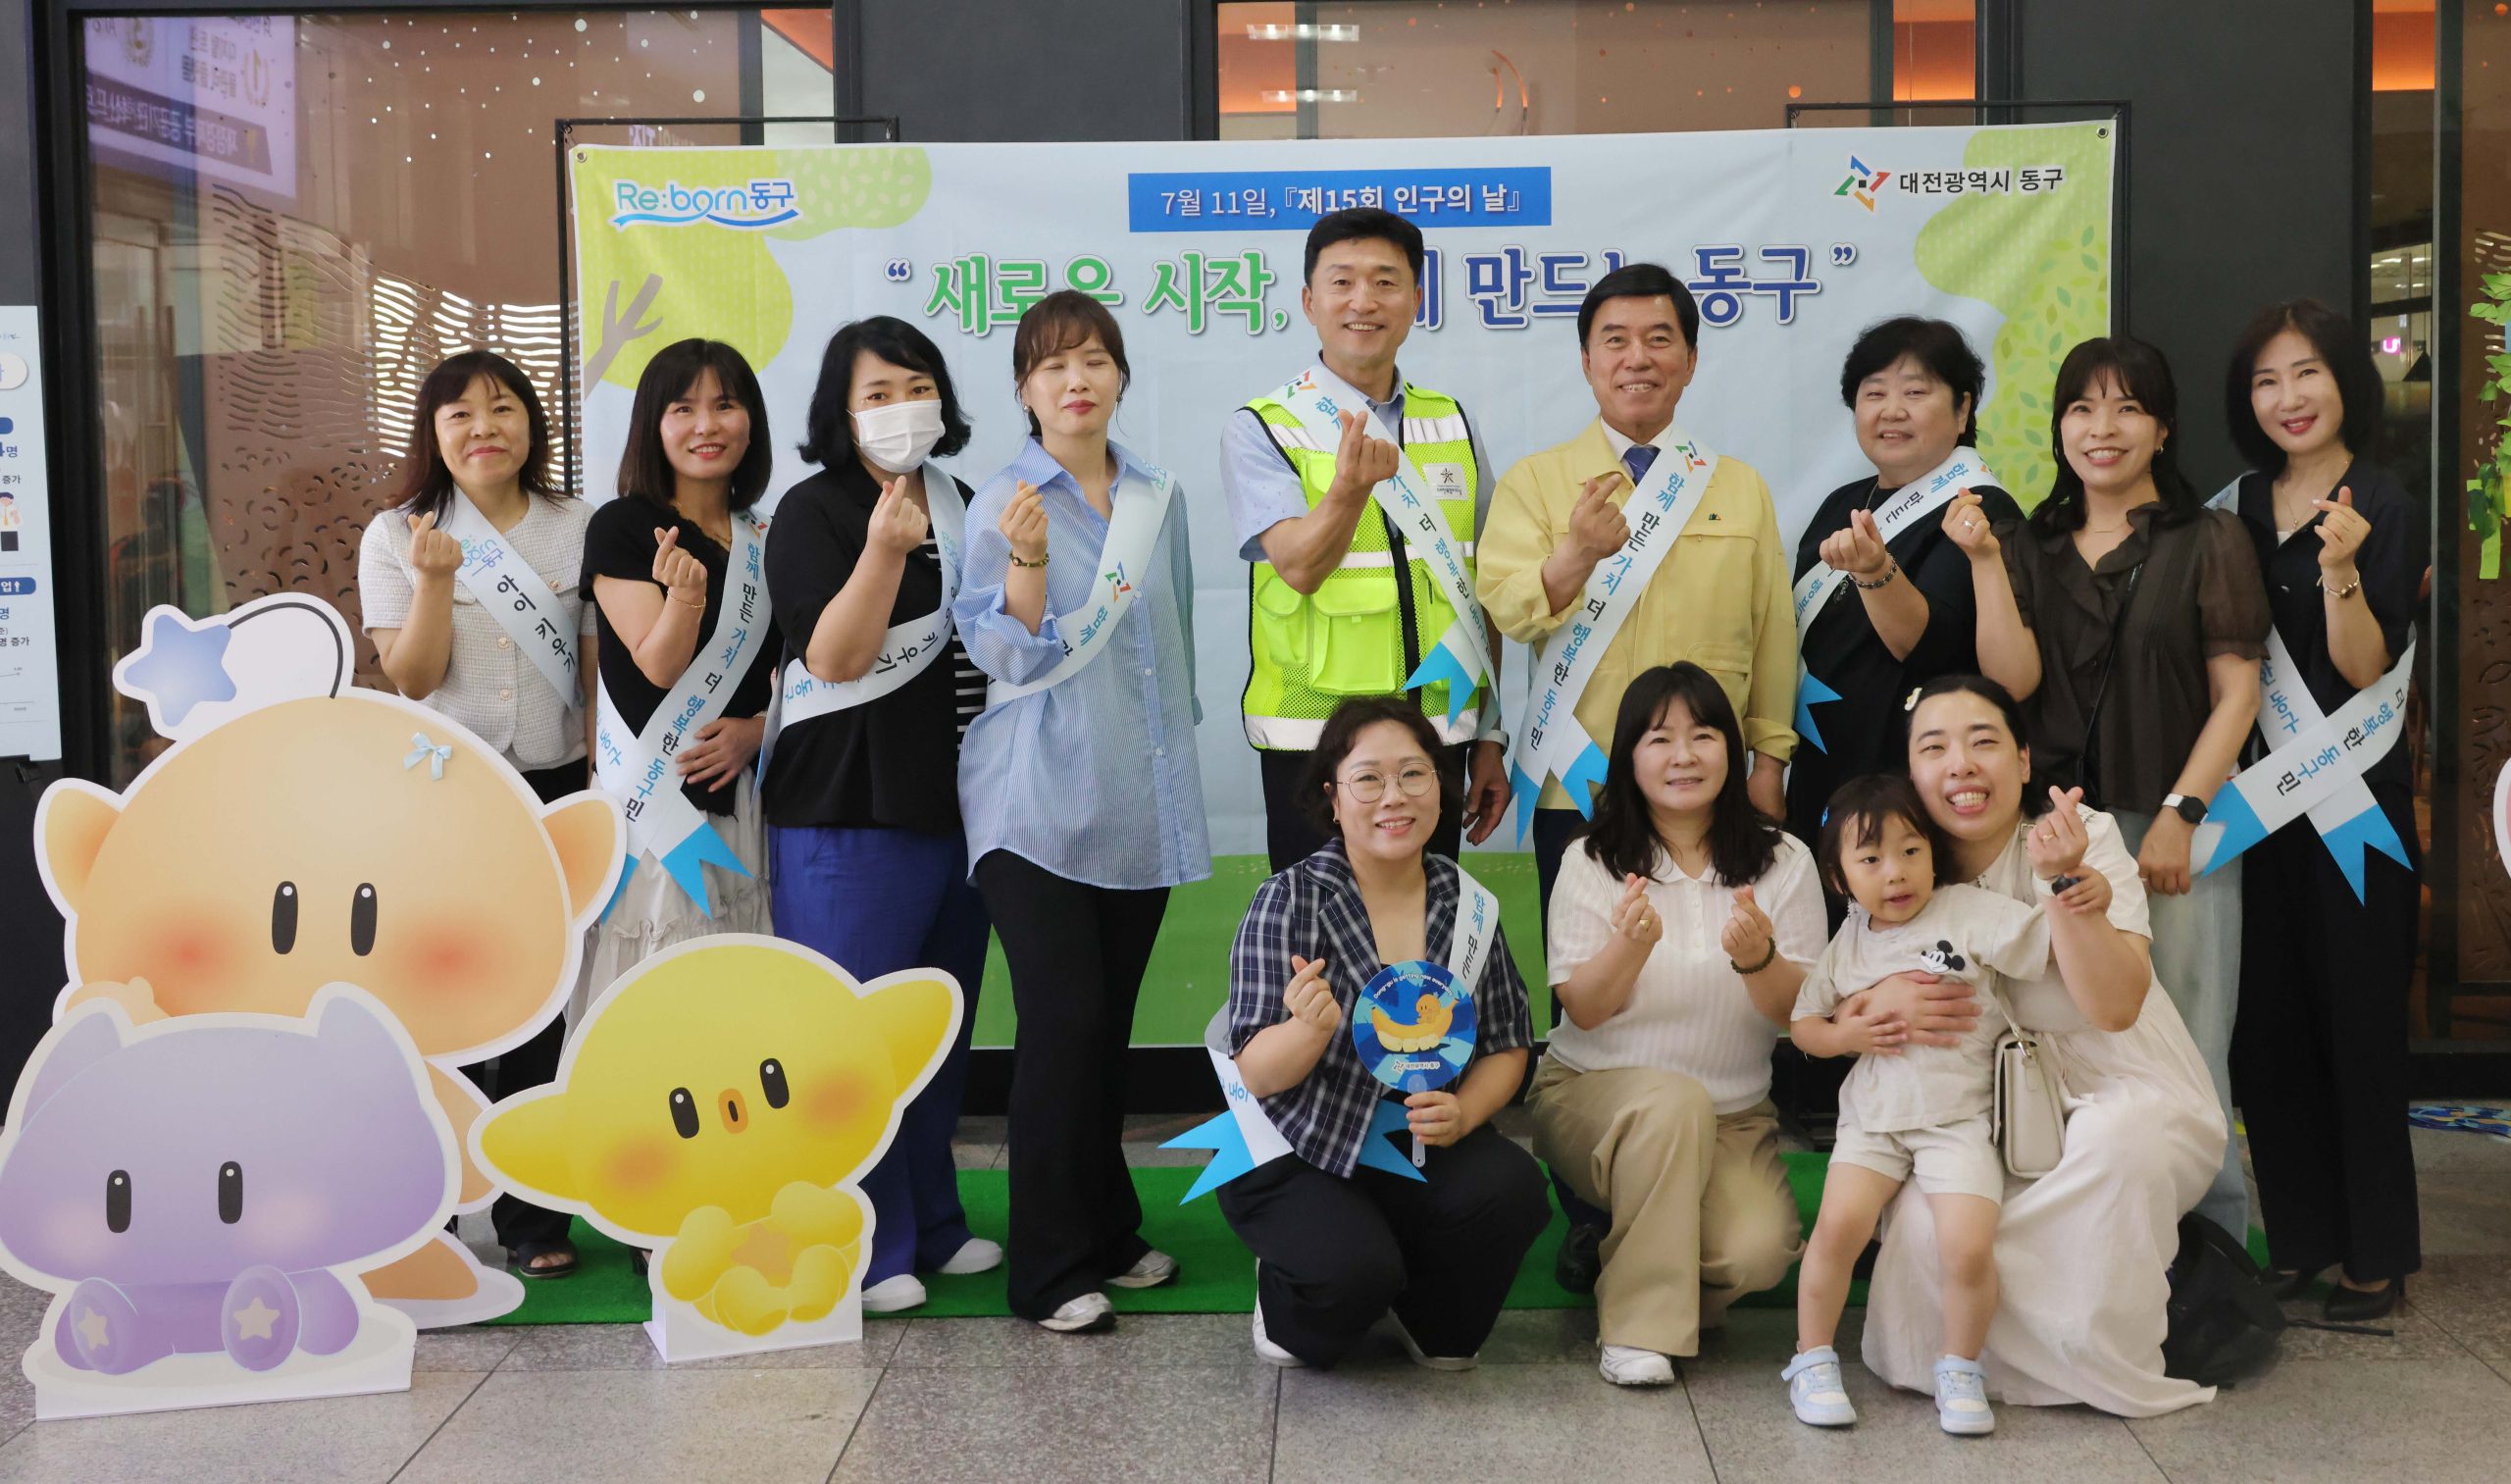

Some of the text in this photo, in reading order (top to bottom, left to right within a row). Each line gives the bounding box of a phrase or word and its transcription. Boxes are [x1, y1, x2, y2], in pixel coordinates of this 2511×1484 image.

[1160, 188, 1202, 217] 7월
[1211, 187, 1276, 218] 11일,
[1394, 183, 1471, 213] 인구의
[1482, 182, 1519, 212] 날』
[1900, 169, 2064, 193] 대전광역시 동구
[1146, 250, 1286, 334] 시작,
[1687, 247, 1819, 326] 동구
[3, 475, 21, 485] 증가
[1885, 462, 1971, 525] 함께 만든
[1418, 513, 1437, 533] 더
[1435, 537, 1469, 599] 행복한
[1528, 471, 1685, 751] 함께 만든 가치 더 행복한 동구민
[1795, 577, 1824, 617] 행복
[11, 638, 29, 647] 증가
[496, 573, 577, 675] 아이 키우기
[1079, 605, 1109, 647] 함께
[876, 631, 939, 675] 키우기
[625, 541, 761, 824] 함께 만든 가치 더 행복한 동구민
[785, 678, 814, 705] 동구
[2269, 690, 2300, 734] 동구
[2342, 700, 2394, 751] 행복한
[599, 729, 622, 766] 동구
[2276, 744, 2342, 796] 동구민
[1461, 890, 1485, 980] 함께 만든
